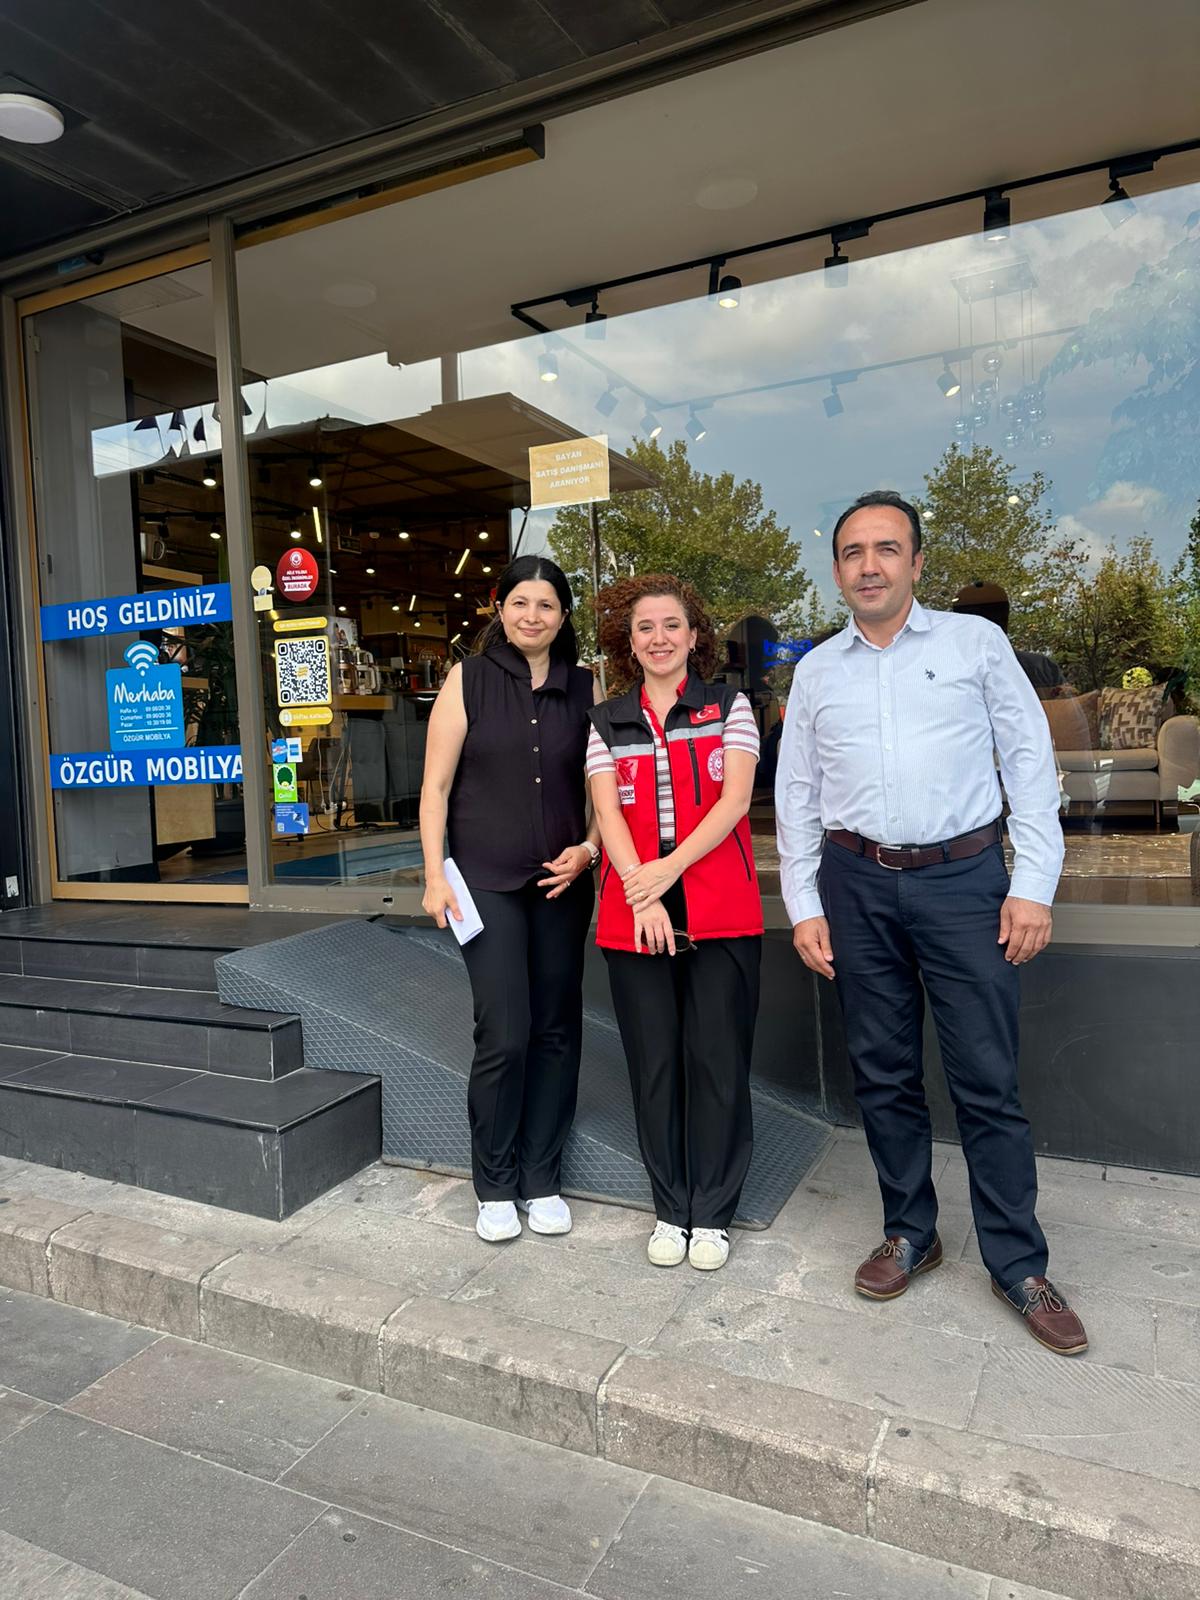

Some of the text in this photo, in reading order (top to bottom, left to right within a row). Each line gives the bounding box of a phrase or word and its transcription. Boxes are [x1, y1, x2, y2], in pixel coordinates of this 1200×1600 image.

[555, 450, 582, 461] BAYAN
[549, 475, 590, 489] ARANIYOR
[68, 589, 217, 632] HOŞ GELDİNİZ
[114, 681, 176, 704] Merhaba
[123, 733, 144, 743] ÖZGÜR
[60, 750, 243, 785] ÖZGÜR MOBİLYA
